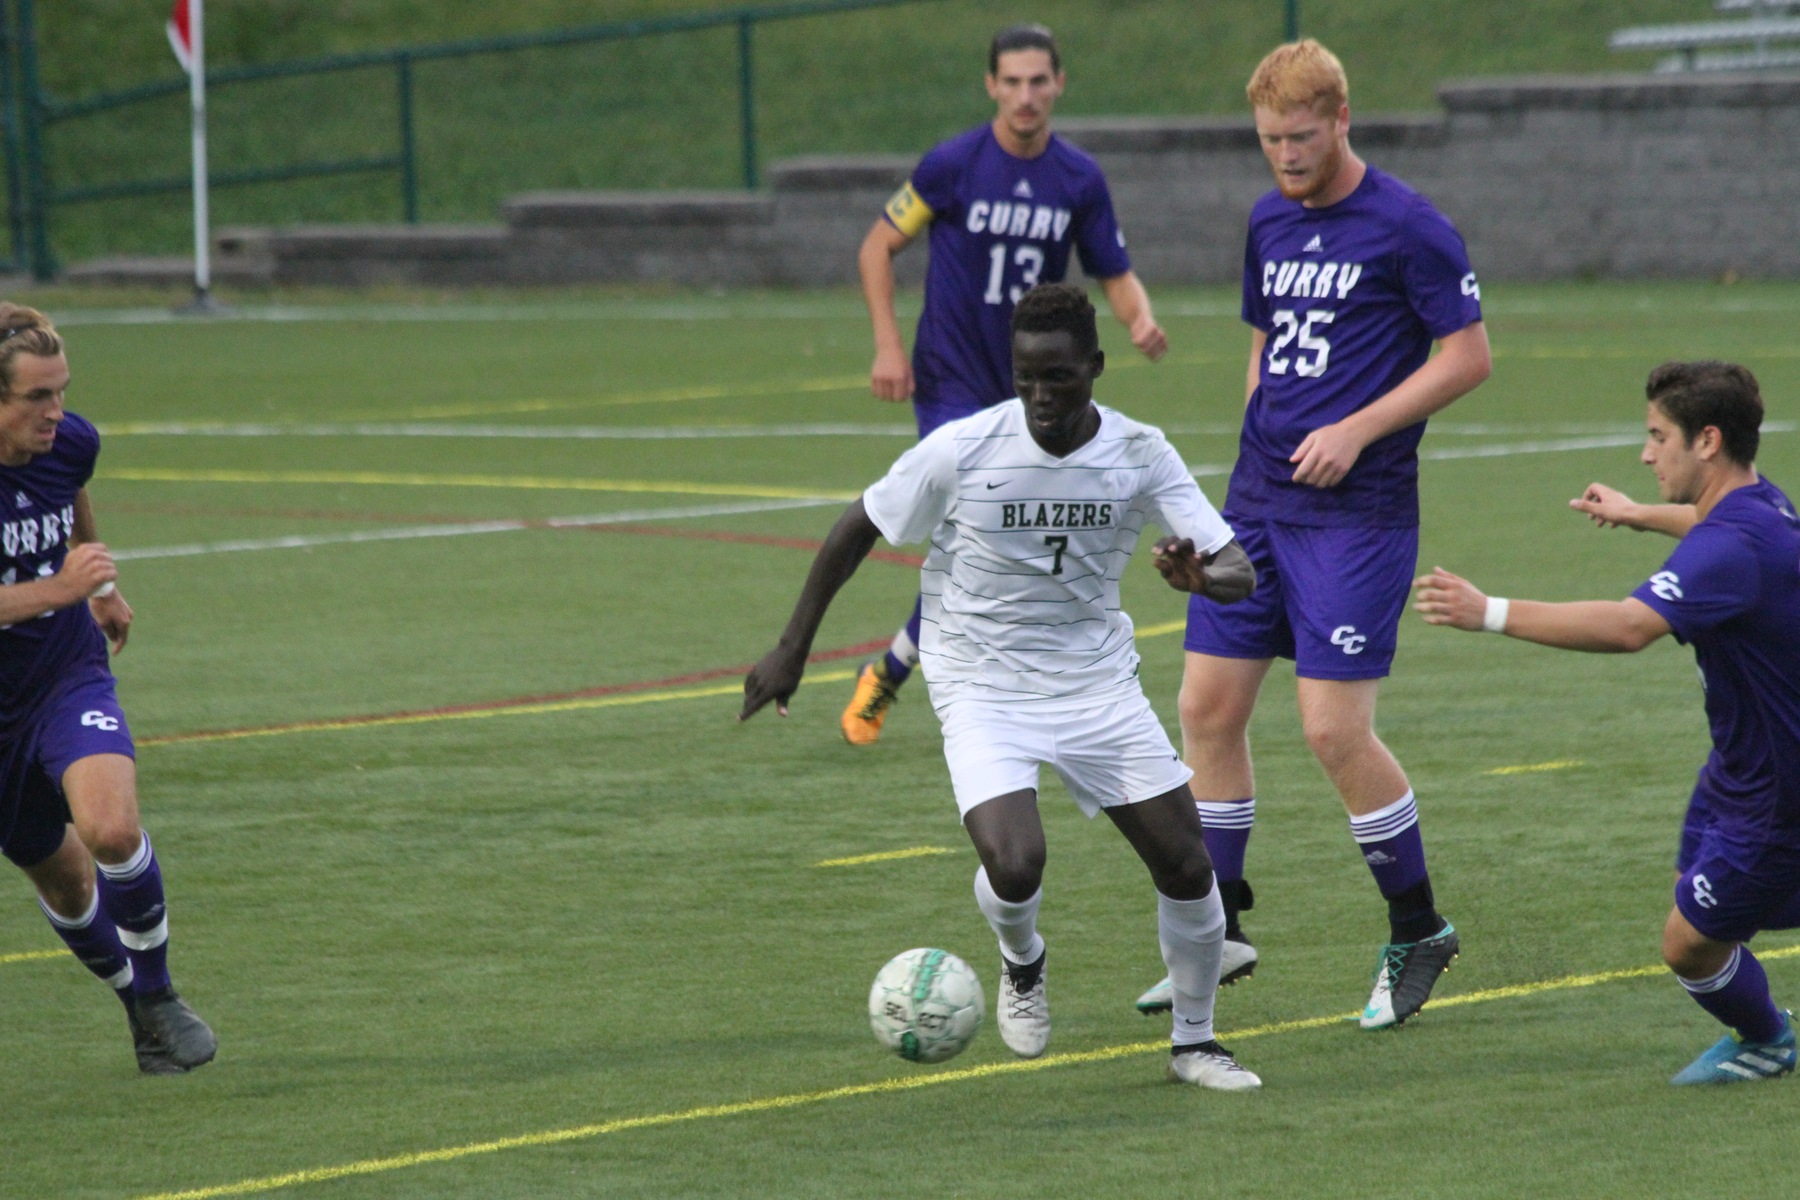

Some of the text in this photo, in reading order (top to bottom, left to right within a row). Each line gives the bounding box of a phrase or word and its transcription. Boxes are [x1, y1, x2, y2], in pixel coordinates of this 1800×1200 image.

[966, 200, 1072, 242] CURRY
[984, 243, 1044, 305] 13
[1262, 260, 1362, 299] CURRY
[1268, 309, 1336, 378] 25
[1002, 503, 1112, 528] BLAZERS
[1044, 535, 1068, 576] 7
